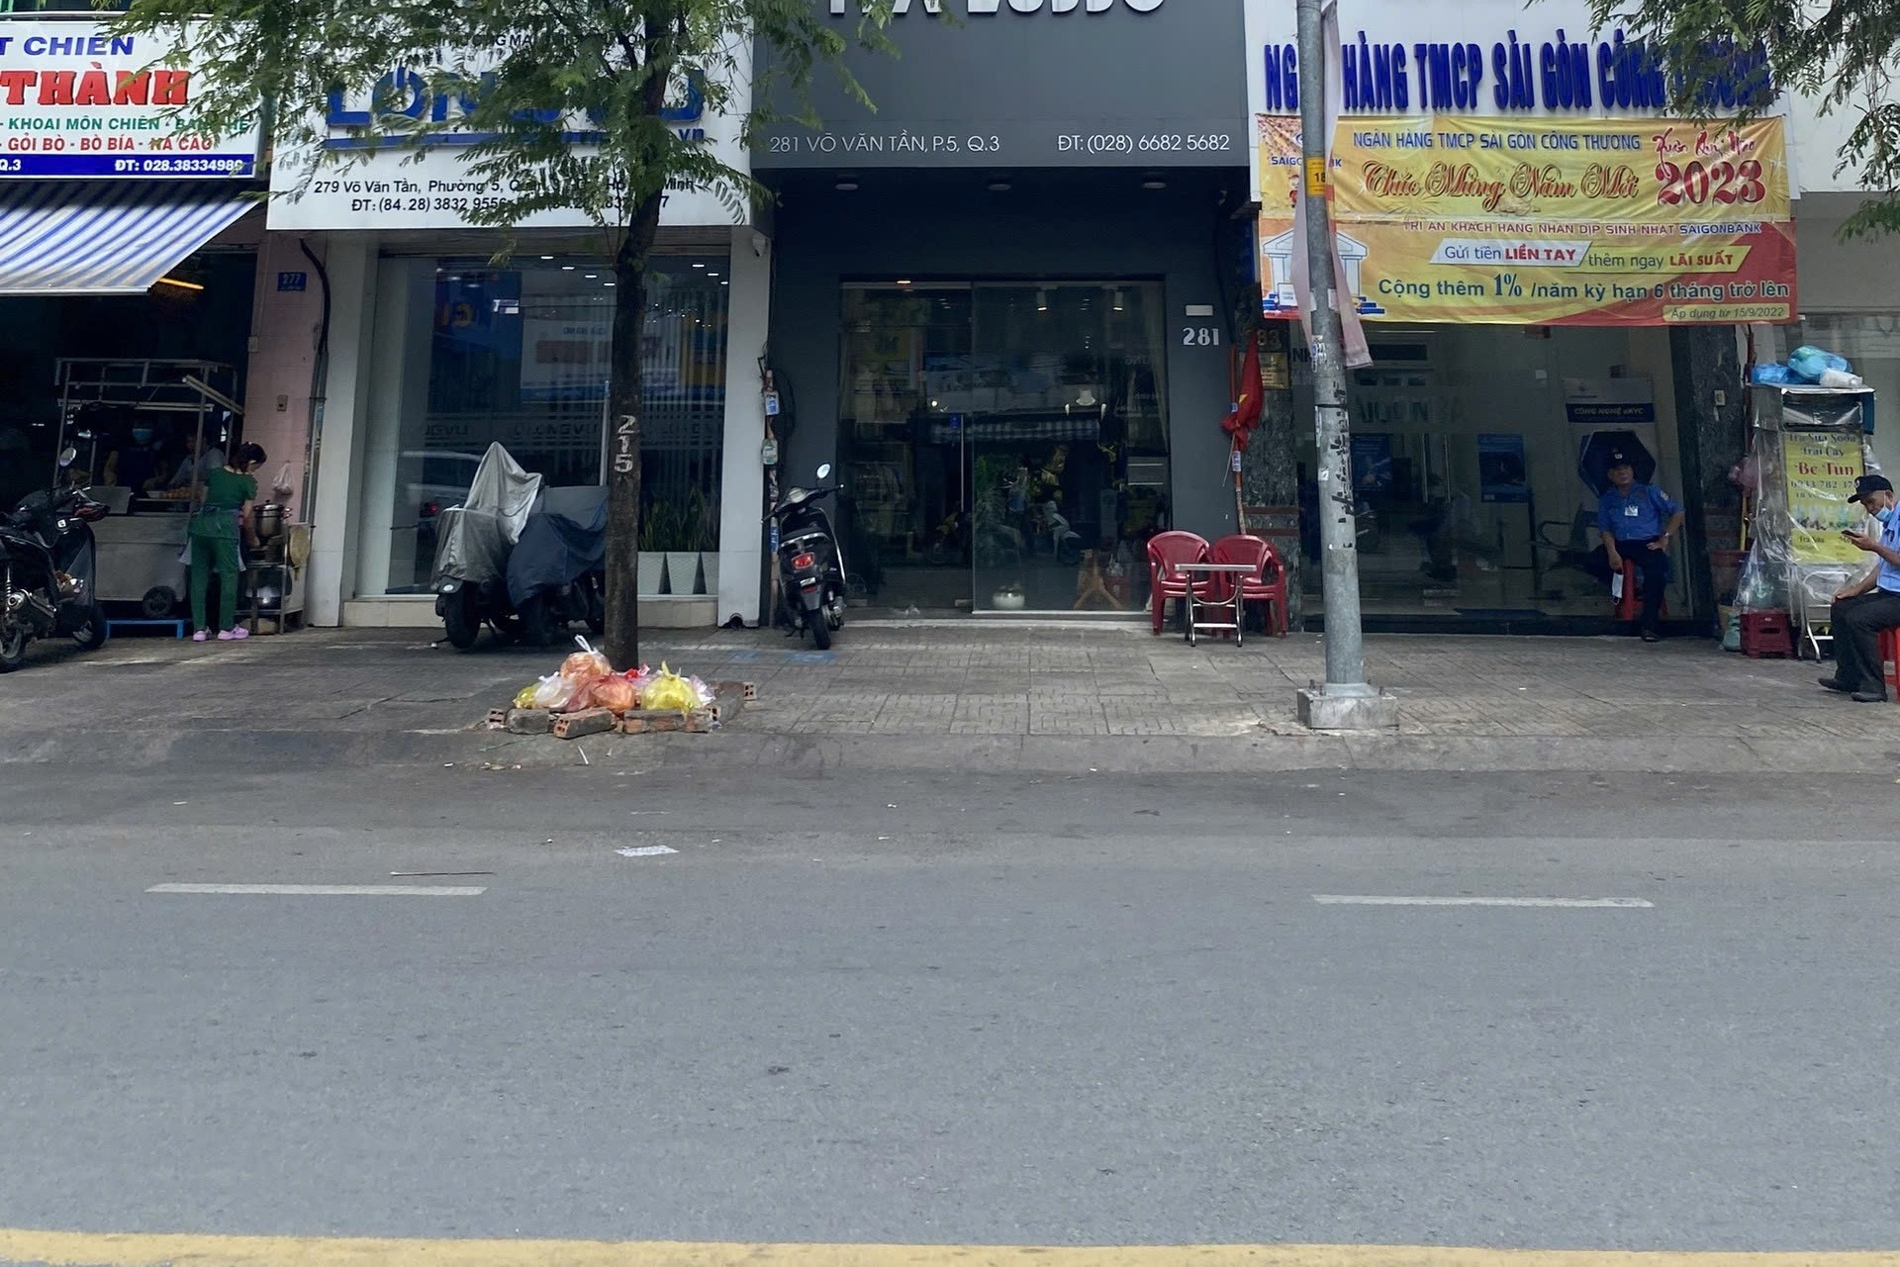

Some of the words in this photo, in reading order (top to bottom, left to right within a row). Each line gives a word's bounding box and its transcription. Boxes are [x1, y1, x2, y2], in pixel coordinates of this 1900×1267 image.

[1341, 30, 1408, 111] HÀNG
[1414, 43, 1483, 111] TMCP
[1493, 29, 1535, 111] SÀI
[1539, 28, 1592, 111] GÒN
[0, 61, 191, 106] THÀNH
[8, 117, 60, 130] KHOAI
[66, 114, 103, 130] MÔN
[108, 114, 160, 130] CHIÊN
[42, 134, 65, 151] BÒ
[80, 134, 103, 151] BÒ
[107, 134, 135, 151] BÍA
[769, 136, 799, 153] 281
[806, 132, 836, 152] VÕ
[842, 133, 883, 152] VĂN
[888, 129, 929, 153] TẦN,
[967, 135, 1000, 152] Q.3
[1057, 134, 1084, 152] ĐT:
[1086, 134, 1133, 154] (028)
[1138, 134, 1181, 152] 6682
[1186, 134, 1230, 152] 5682
[1353, 131, 1392, 148] NGÂN
[1396, 129, 1433, 148] HÀNG
[1437, 133, 1475, 149] TMCP
[1480, 130, 1502, 149] SÀI
[1507, 130, 1536, 149] GÒN
[1541, 130, 1579, 150] CÔNG
[1583, 133, 1641, 151] THƯƠNG
[115, 159, 140, 172] ĐT:
[314, 180, 339, 193] 279
[344, 181, 361, 193] Võ
[365, 180, 390, 193] Văn
[428, 179, 485, 195] Phường
[1361, 160, 1421, 198] Chúc
[1510, 162, 1578, 199] Năm
[1580, 162, 1640, 199] Mới
[1654, 160, 1766, 206] 2023
[351, 199, 376, 212] ĐT:
[379, 197, 430, 213] (84.28)
[434, 198, 468, 211] 3832
[1605, 224, 1637, 235] SINH
[1679, 222, 1762, 234] SAIGONBANK
[1444, 245, 1470, 260] Gửi
[1474, 245, 1501, 260] tiền
[1543, 248, 1577, 261] TAY
[1588, 253, 1625, 267] thêm
[1630, 256, 1665, 270] ngay
[1669, 252, 1693, 267] LÃI
[1696, 250, 1733, 267] SUẤT
[1378, 278, 1431, 299] Cộng
[1437, 279, 1486, 297] thêm
[1493, 272, 1522, 298] 1%
[1530, 281, 1578, 299] /năm
[1584, 282, 1606, 302] kỳ
[1612, 282, 1648, 303] hạn
[1653, 285, 1664, 299] 6
[1669, 282, 1725, 301] tháng
[1729, 281, 1756, 299] trở
[1760, 282, 1790, 298] lên
[1692, 308, 1716, 321] dụng
[1733, 306, 1785, 318] 15/9/2022
[1182, 327, 1220, 346] 281
[613, 414, 637, 473] 215
